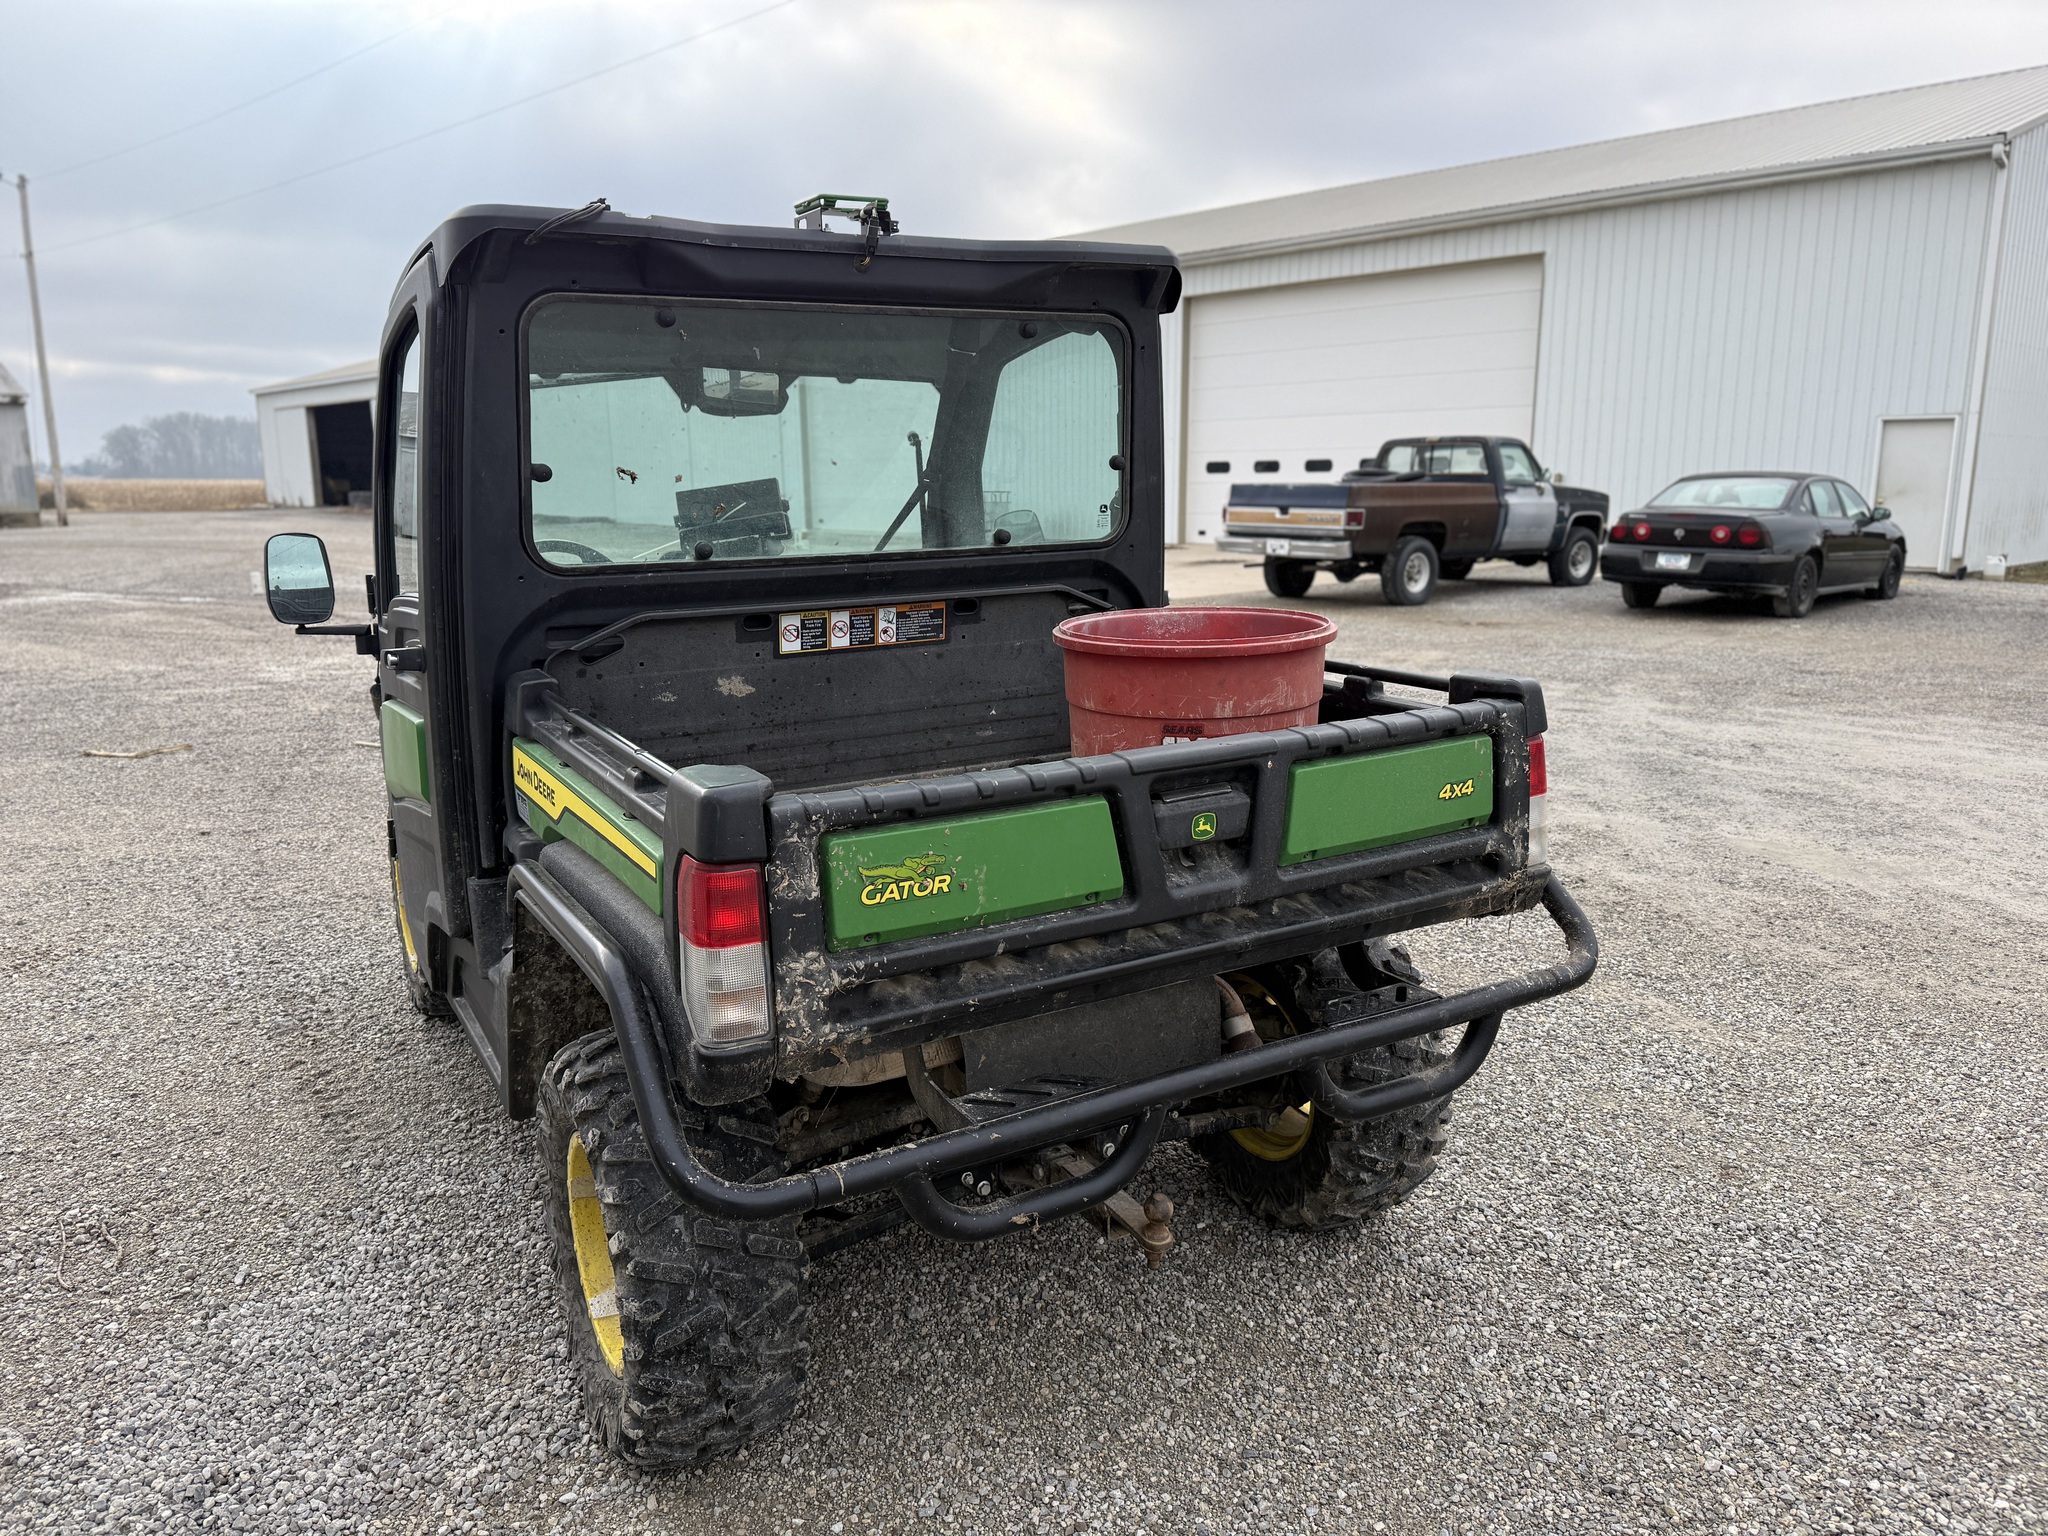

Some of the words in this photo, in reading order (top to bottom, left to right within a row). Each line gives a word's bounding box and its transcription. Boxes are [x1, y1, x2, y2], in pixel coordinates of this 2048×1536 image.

[1162, 724, 1203, 735] SEARS
[517, 757, 533, 787] JOHN
[533, 770, 556, 808] DEERE
[860, 874, 952, 906] GATOR
